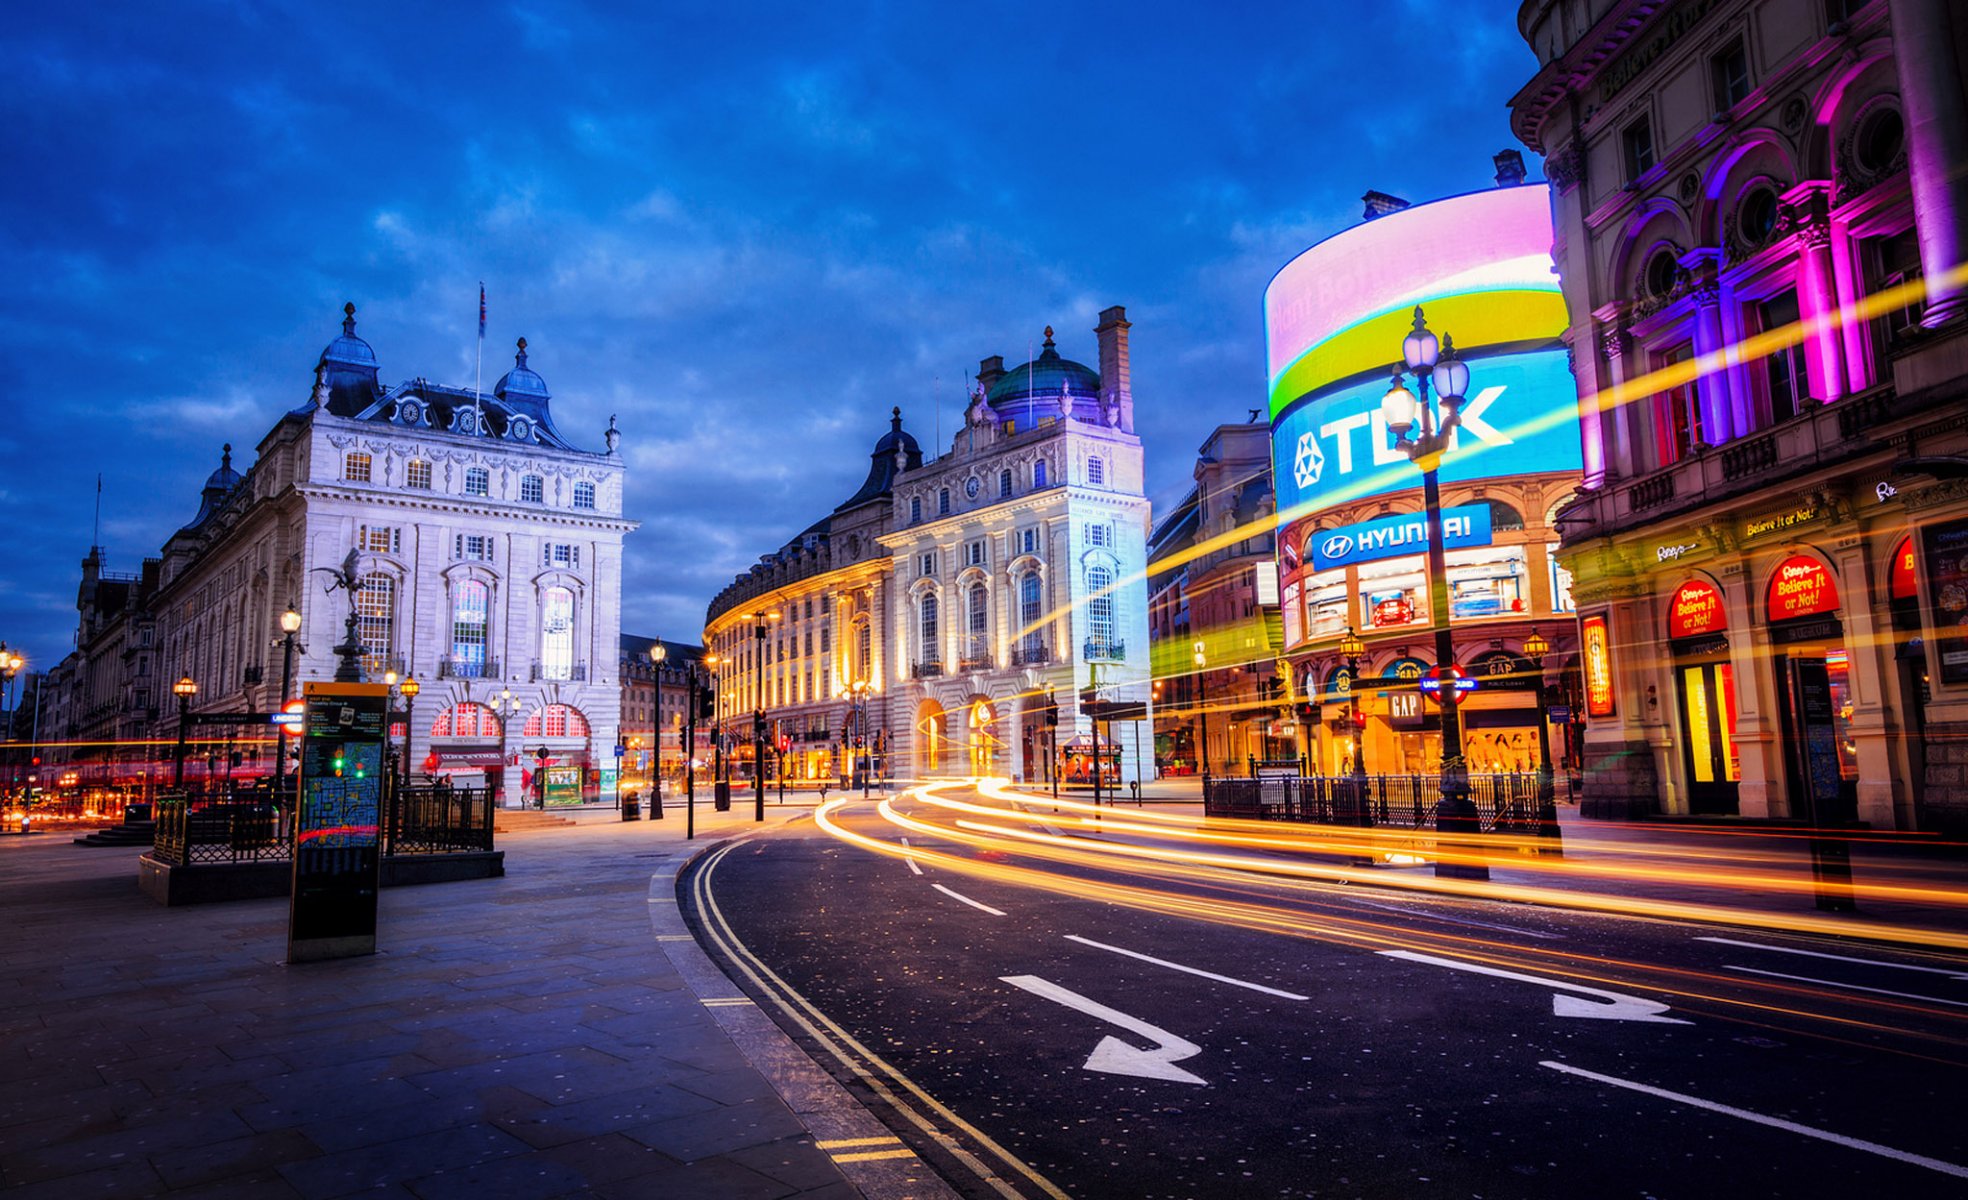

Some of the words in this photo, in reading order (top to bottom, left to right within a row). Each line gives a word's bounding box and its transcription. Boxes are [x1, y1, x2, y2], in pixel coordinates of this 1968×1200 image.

[1320, 385, 1514, 474] TDK
[1358, 516, 1471, 551] HYUNAI
[1747, 520, 1776, 537] Believe
[1776, 515, 1785, 528] It
[1785, 514, 1795, 526] or
[1796, 508, 1814, 523] Not!
[1777, 578, 1813, 596] Believe
[1815, 572, 1825, 588] It
[1677, 601, 1706, 616] Believe
[1707, 596, 1716, 609] It
[1785, 598, 1796, 610] or
[1798, 589, 1820, 608] Not!
[1683, 619, 1693, 629] or
[1694, 611, 1712, 627] Not!
[1423, 681, 1475, 689] UNDOUND
[1392, 695, 1417, 718] GAP
